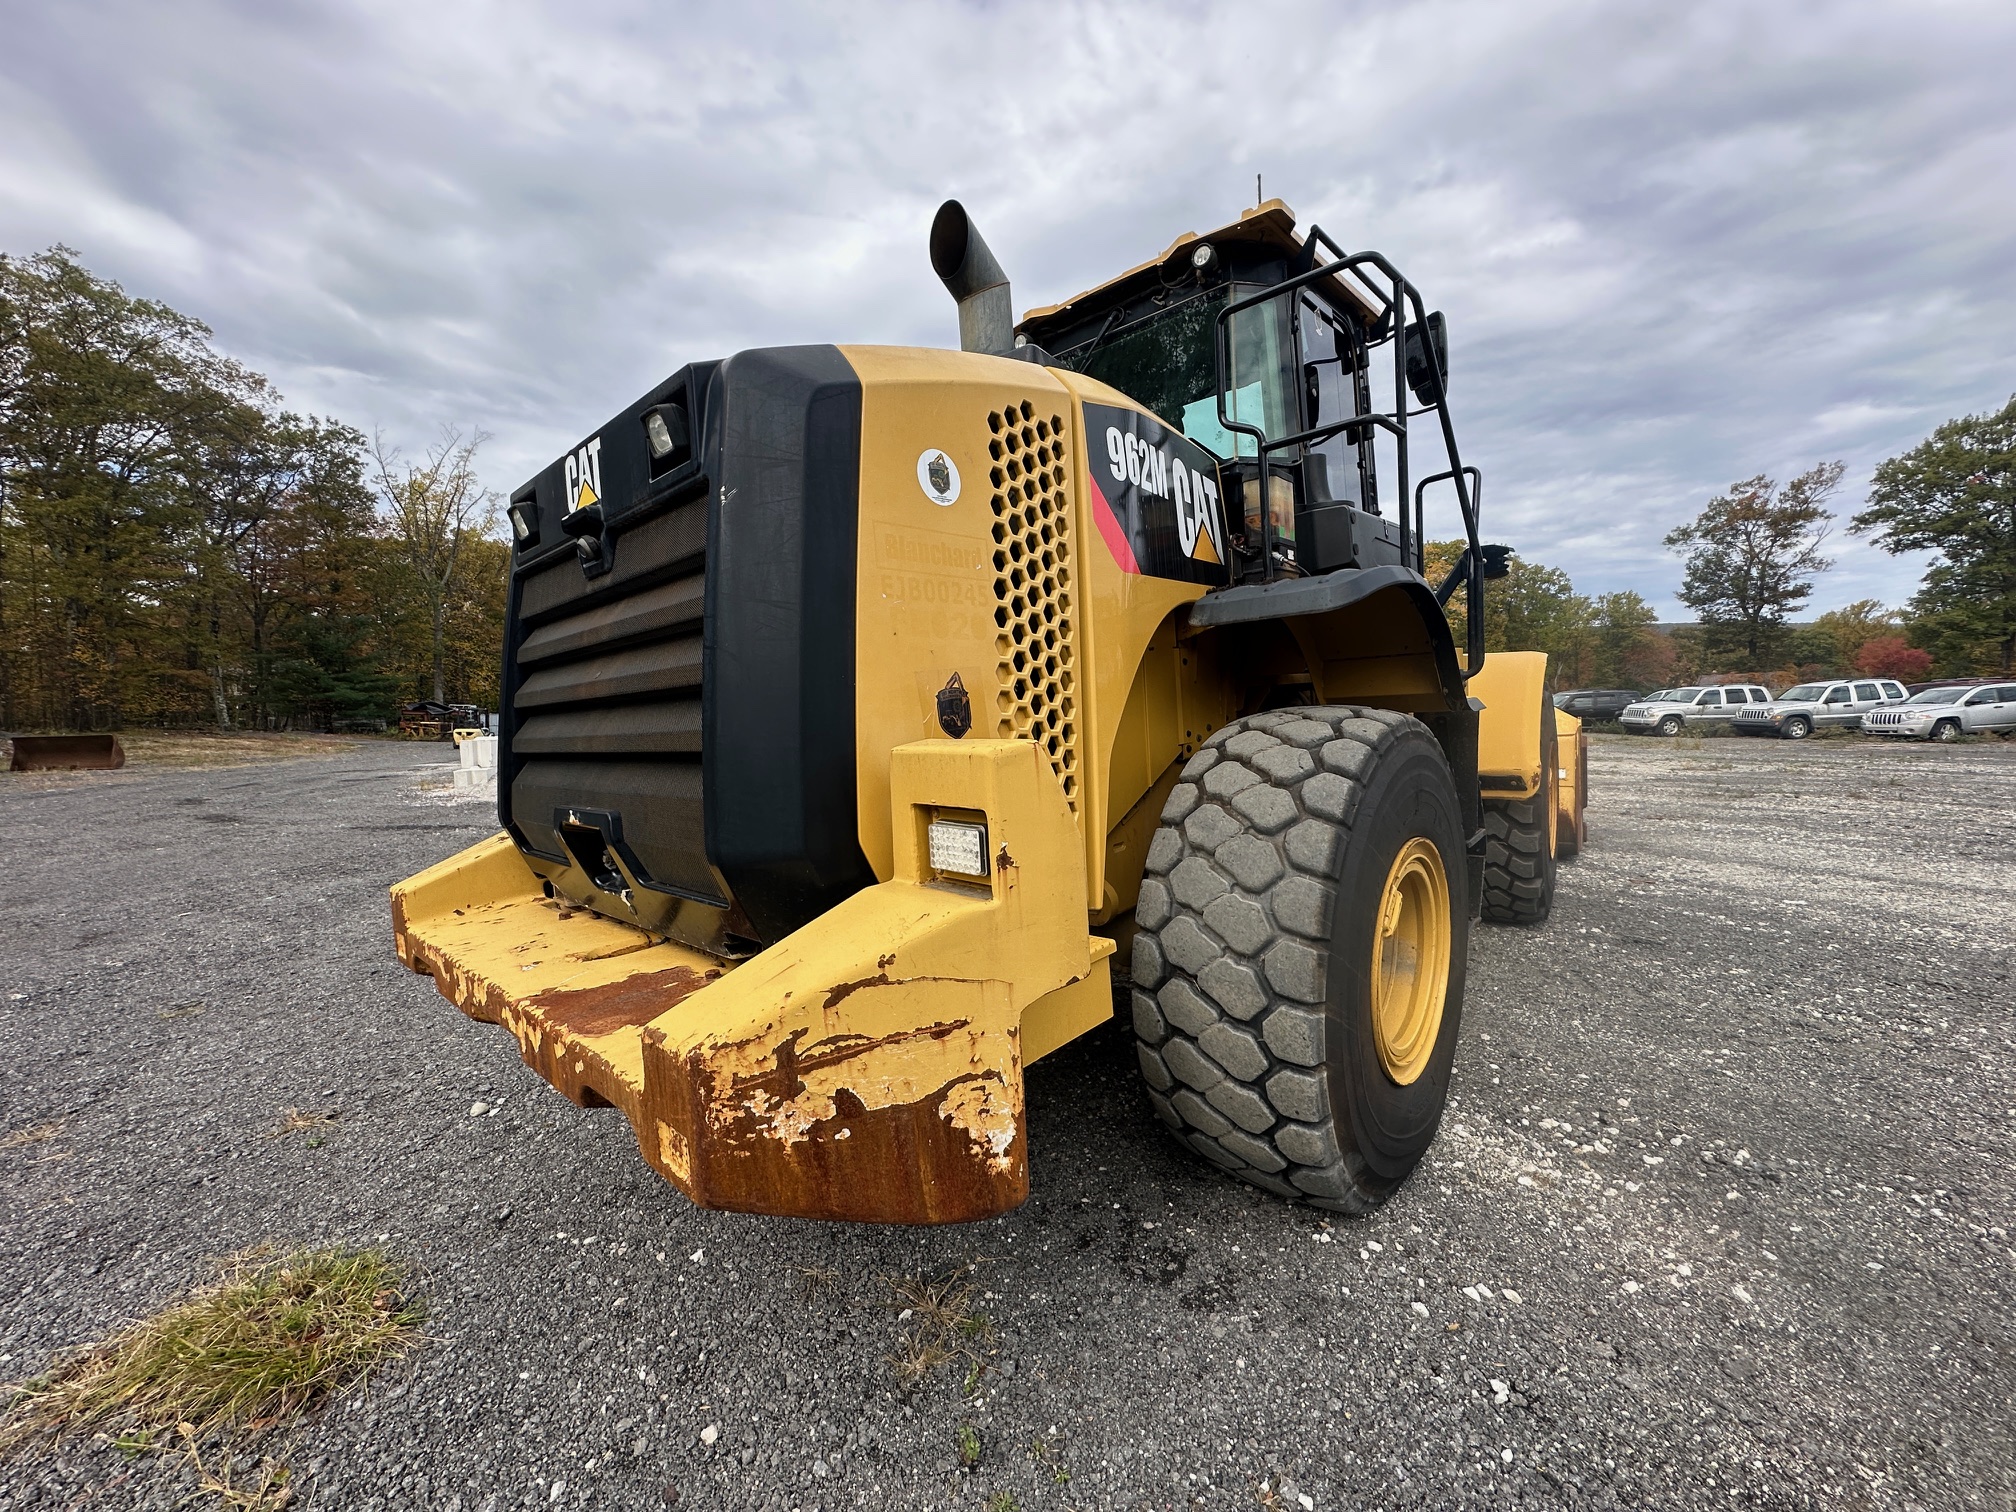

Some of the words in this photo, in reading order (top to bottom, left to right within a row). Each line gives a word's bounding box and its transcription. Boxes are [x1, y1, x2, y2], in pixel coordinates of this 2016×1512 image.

[565, 436, 602, 514] CAT
[1106, 426, 1169, 500] 962M
[1172, 457, 1225, 566] CAT
